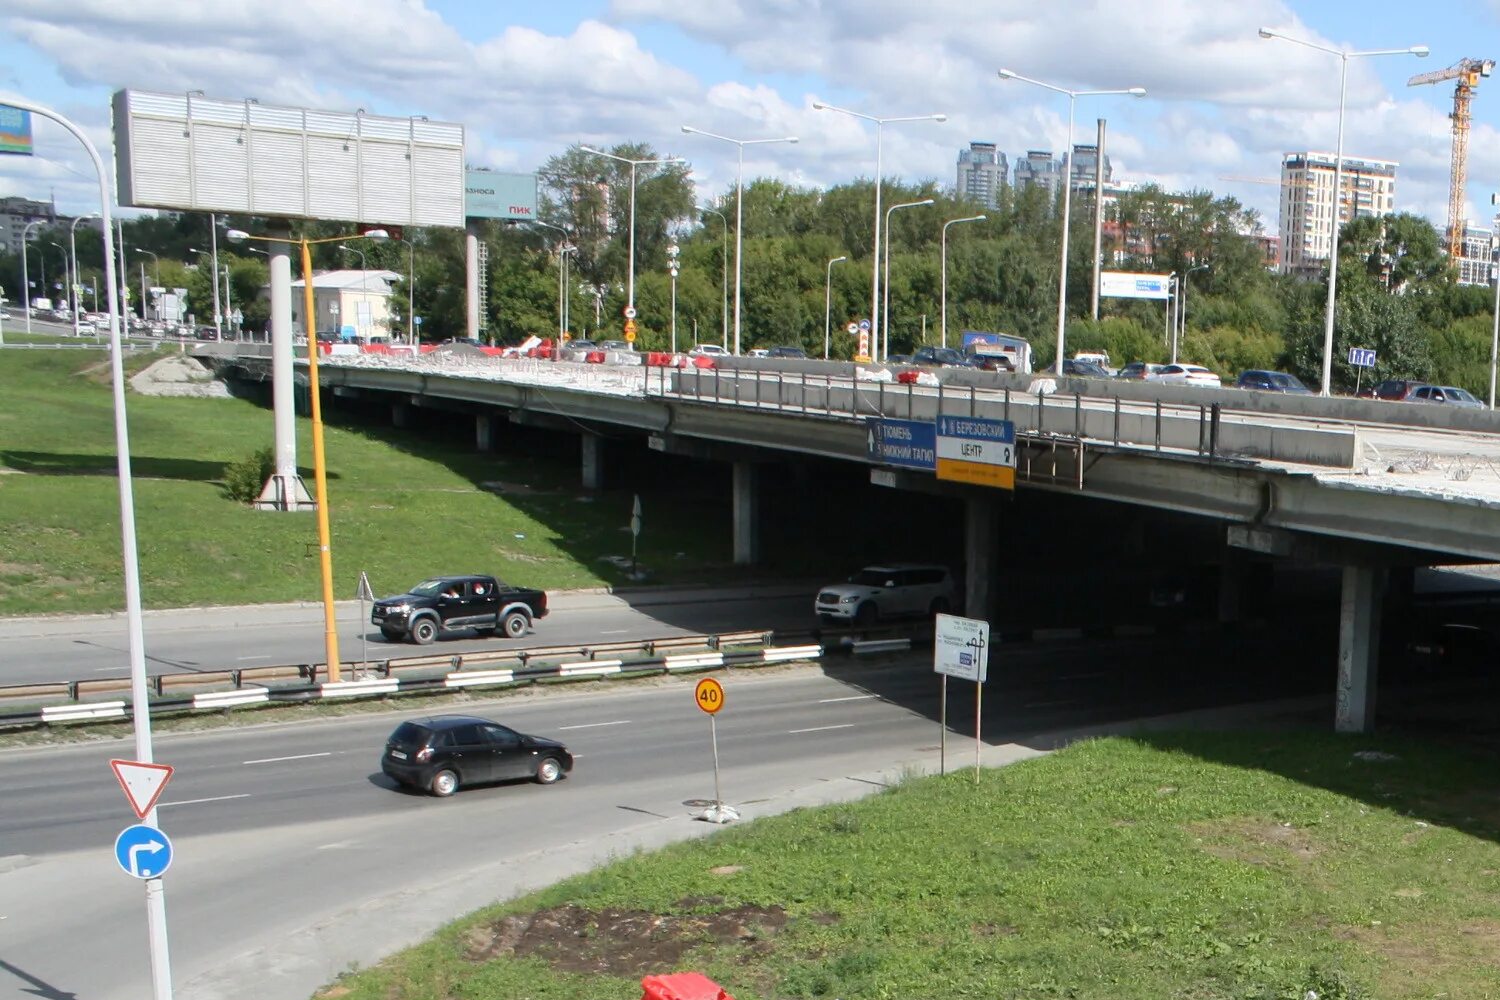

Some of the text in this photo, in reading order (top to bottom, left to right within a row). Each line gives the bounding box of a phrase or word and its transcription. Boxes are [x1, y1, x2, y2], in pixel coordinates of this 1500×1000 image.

[883, 424, 912, 441] ТЮМЕНЬ
[961, 443, 983, 457] ЦЕНТР
[700, 688, 718, 703] 40
